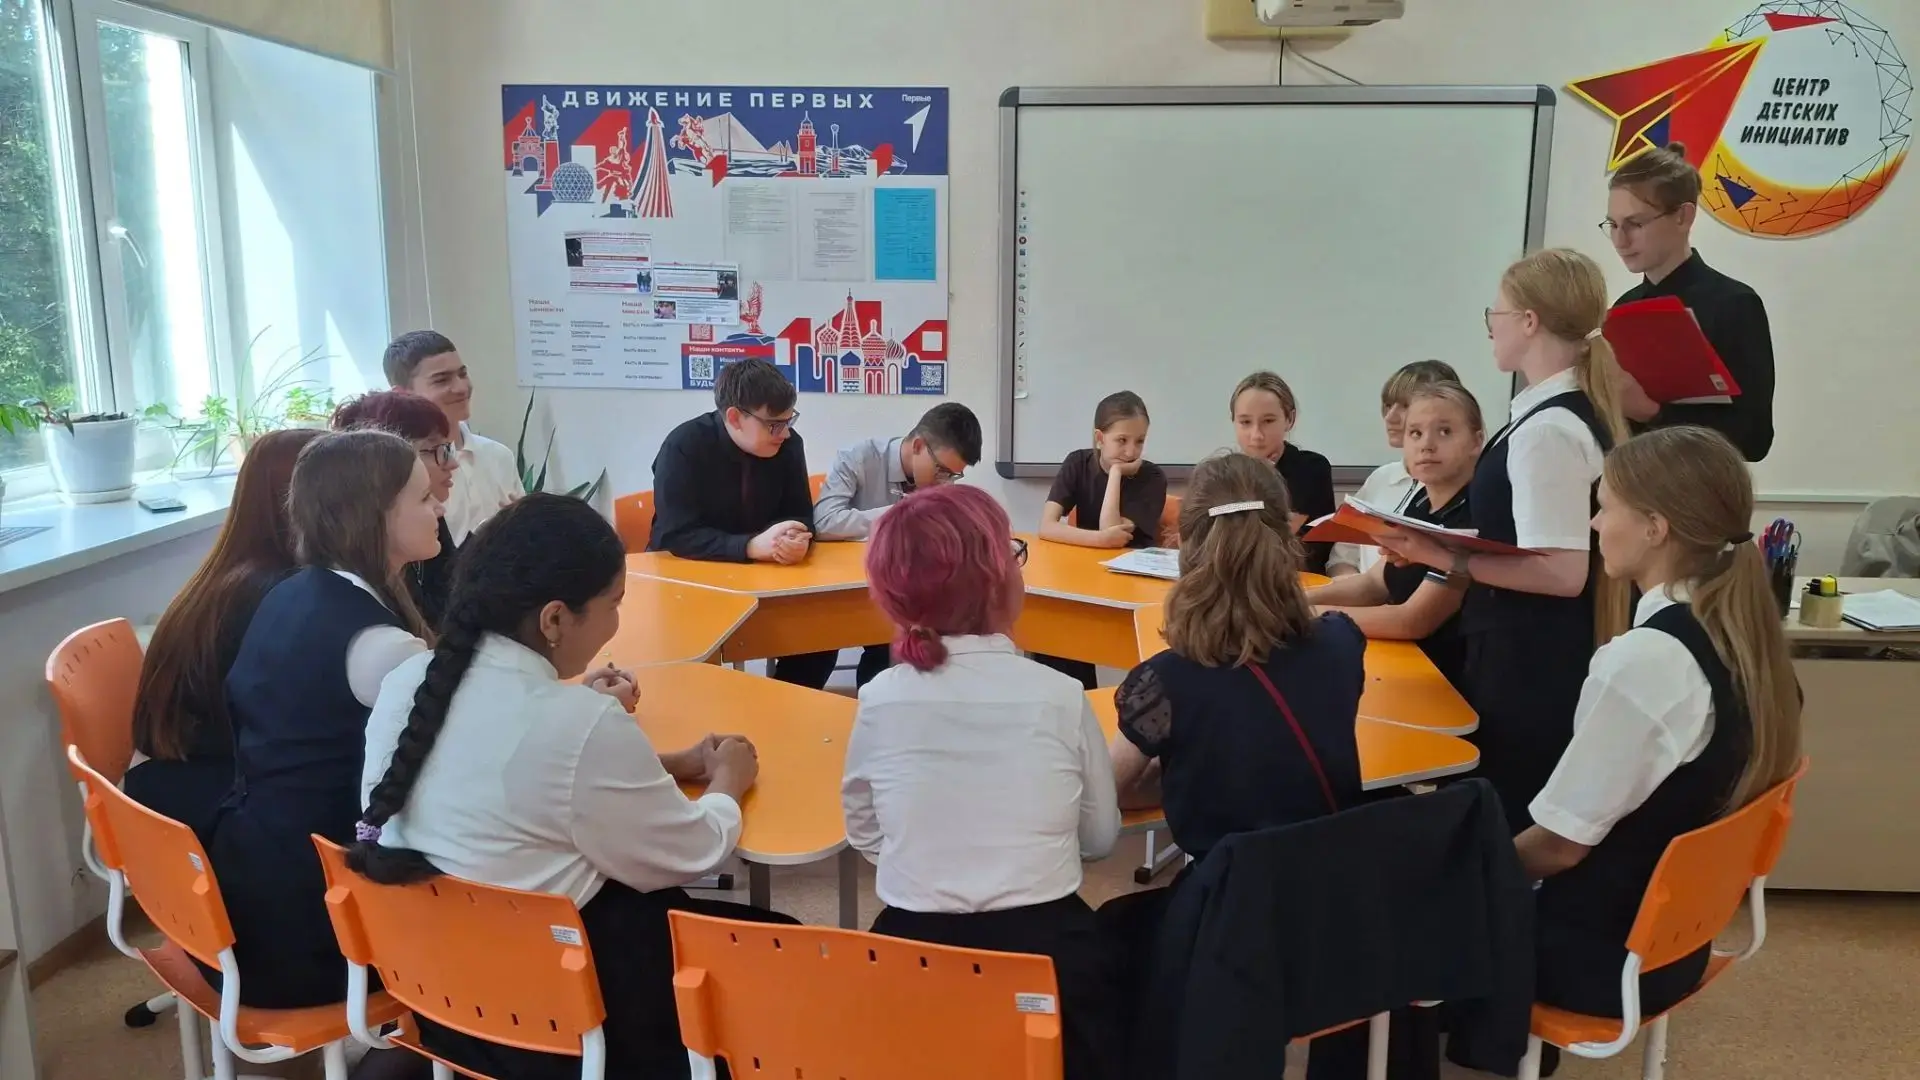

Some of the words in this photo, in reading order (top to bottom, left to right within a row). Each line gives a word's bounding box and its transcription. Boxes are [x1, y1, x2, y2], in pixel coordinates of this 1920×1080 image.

[1772, 78, 1830, 97] ЦЕНТР
[562, 91, 733, 108] ДВИЖЕНИЕ
[750, 93, 874, 109] ПЕРВЫХ
[902, 94, 932, 104] Первые
[1756, 102, 1838, 122] ДЕТСКИХ
[1740, 125, 1849, 146] ИНИЦИАТИВ
[690, 380, 714, 388] БУДЬ
